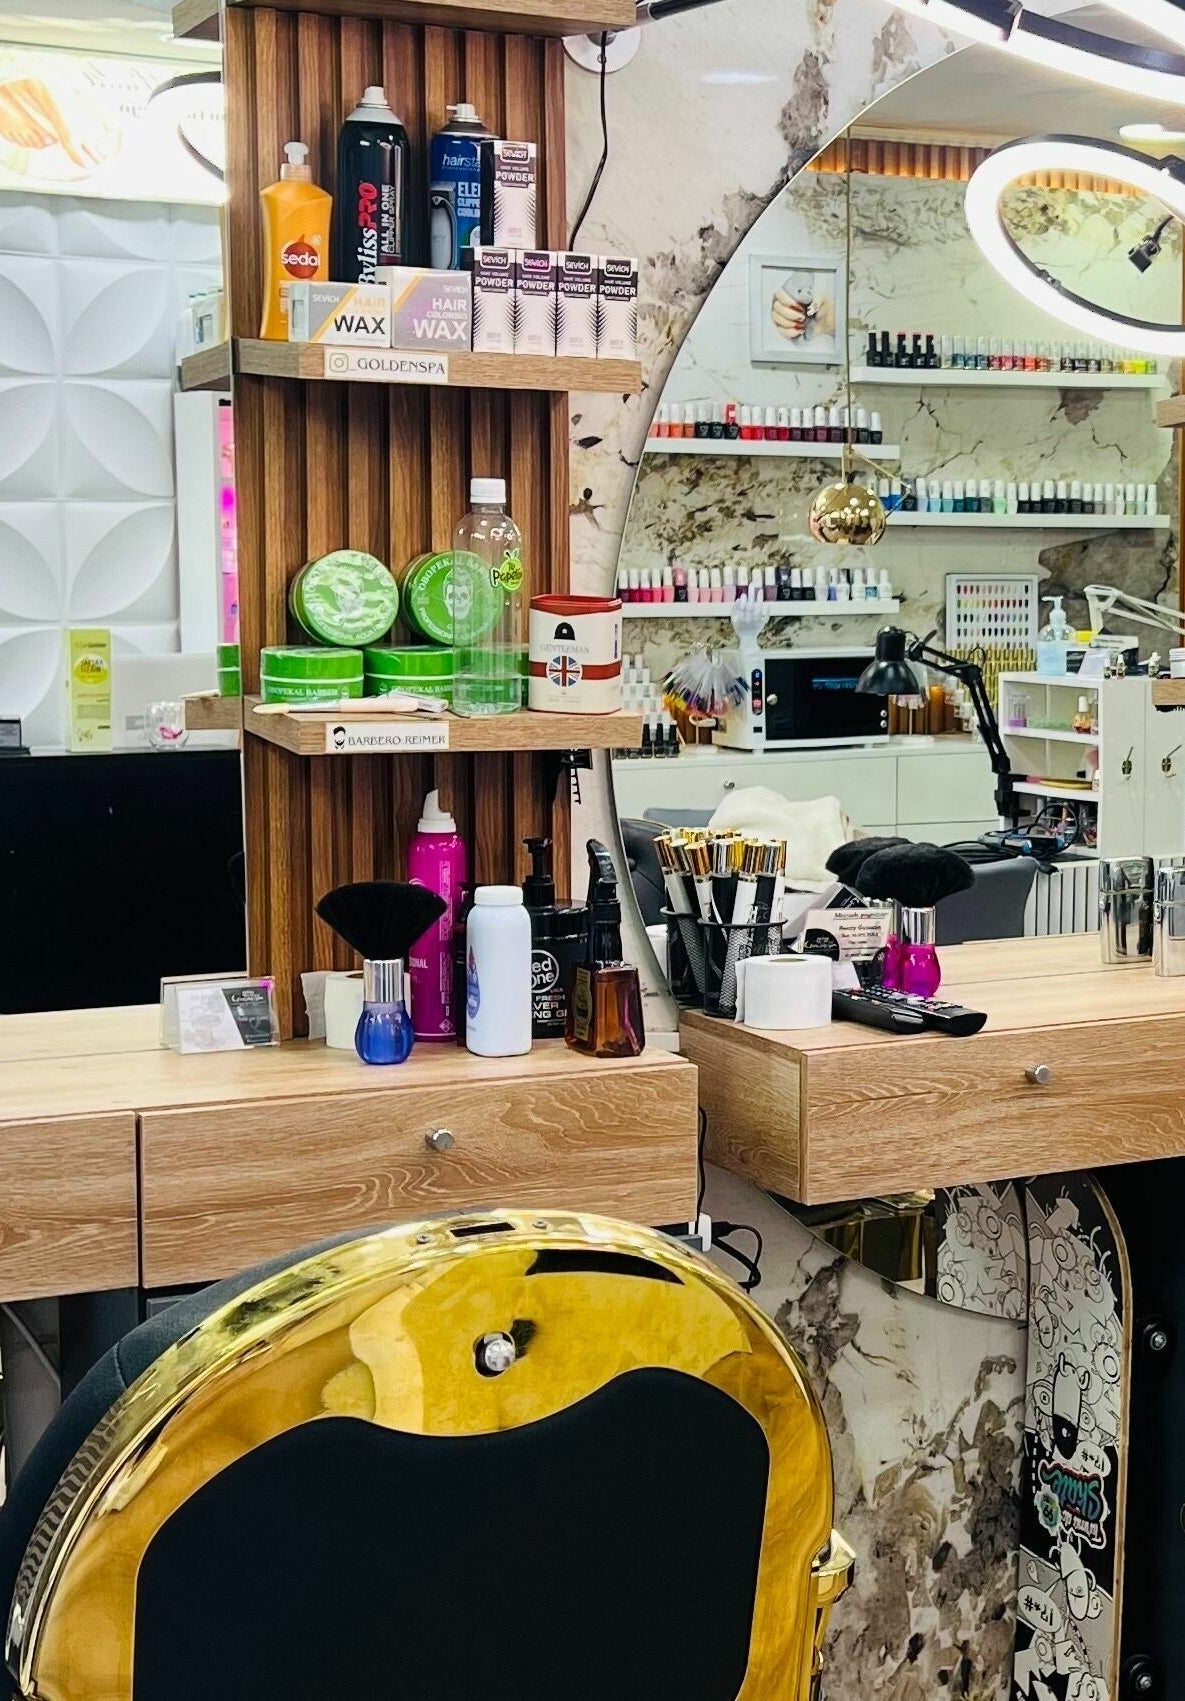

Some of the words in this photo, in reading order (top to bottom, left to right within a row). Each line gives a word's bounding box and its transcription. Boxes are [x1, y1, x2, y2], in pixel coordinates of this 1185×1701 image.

[495, 170, 535, 182] POWDER
[475, 276, 514, 288] POWDER
[517, 280, 555, 290] POWDER
[558, 282, 596, 292] POWDER
[600, 285, 636, 296] POWDER
[432, 298, 467, 311] HAIR
[334, 315, 386, 335] WAX
[412, 318, 467, 340] WAX
[348, 736, 402, 746] BARBERO
[405, 736, 446, 745] REIMER
[531, 957, 552, 973] ed
